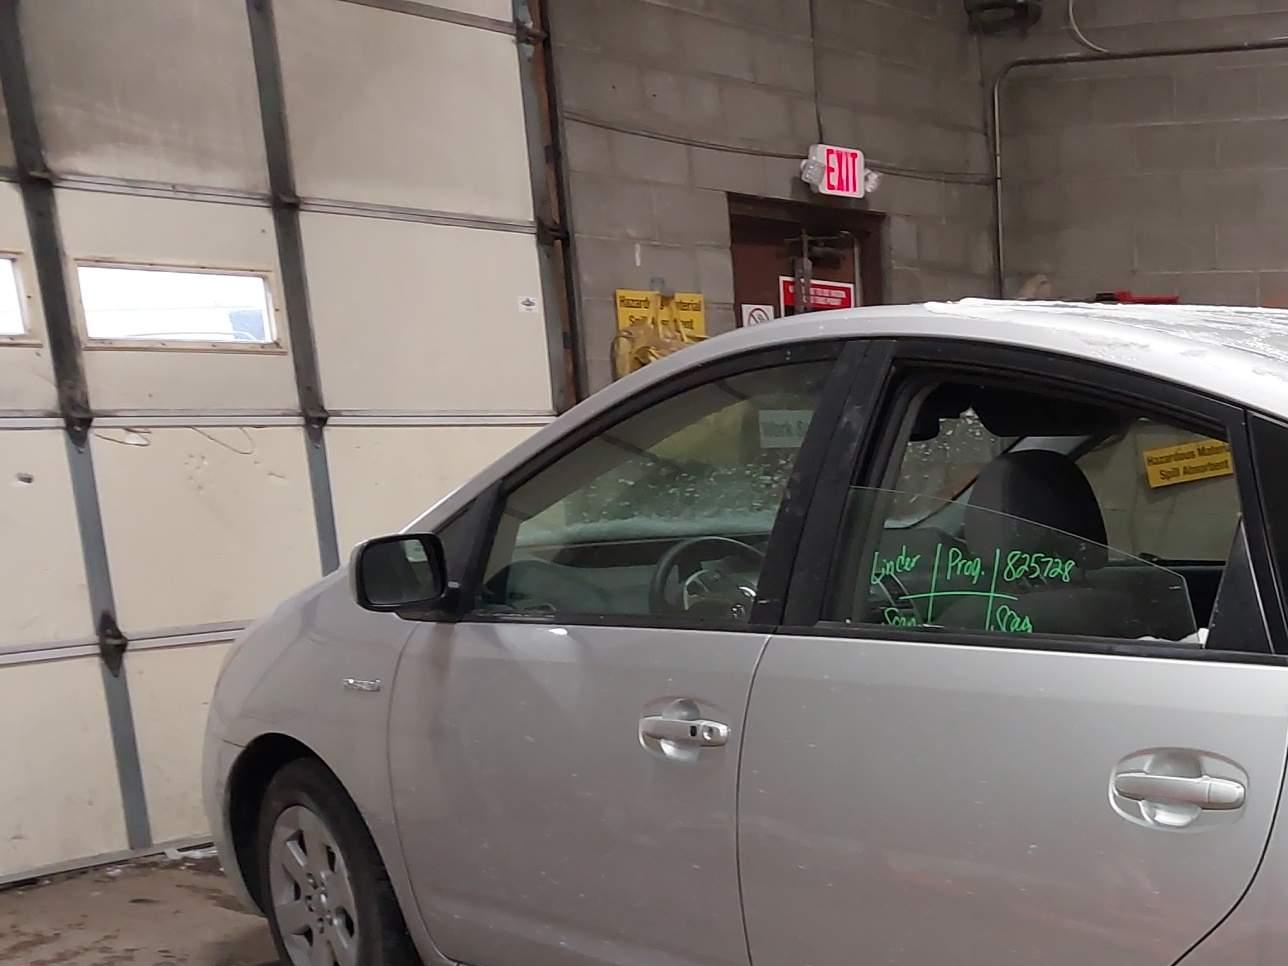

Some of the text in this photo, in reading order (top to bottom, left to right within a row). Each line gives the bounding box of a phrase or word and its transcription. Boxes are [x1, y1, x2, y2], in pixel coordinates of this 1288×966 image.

[826, 148, 858, 192] EXIT
[1147, 451, 1196, 466] Hazardous
[1160, 460, 1230, 480] Spill Absorbent
[1003, 550, 1077, 583] 825728
